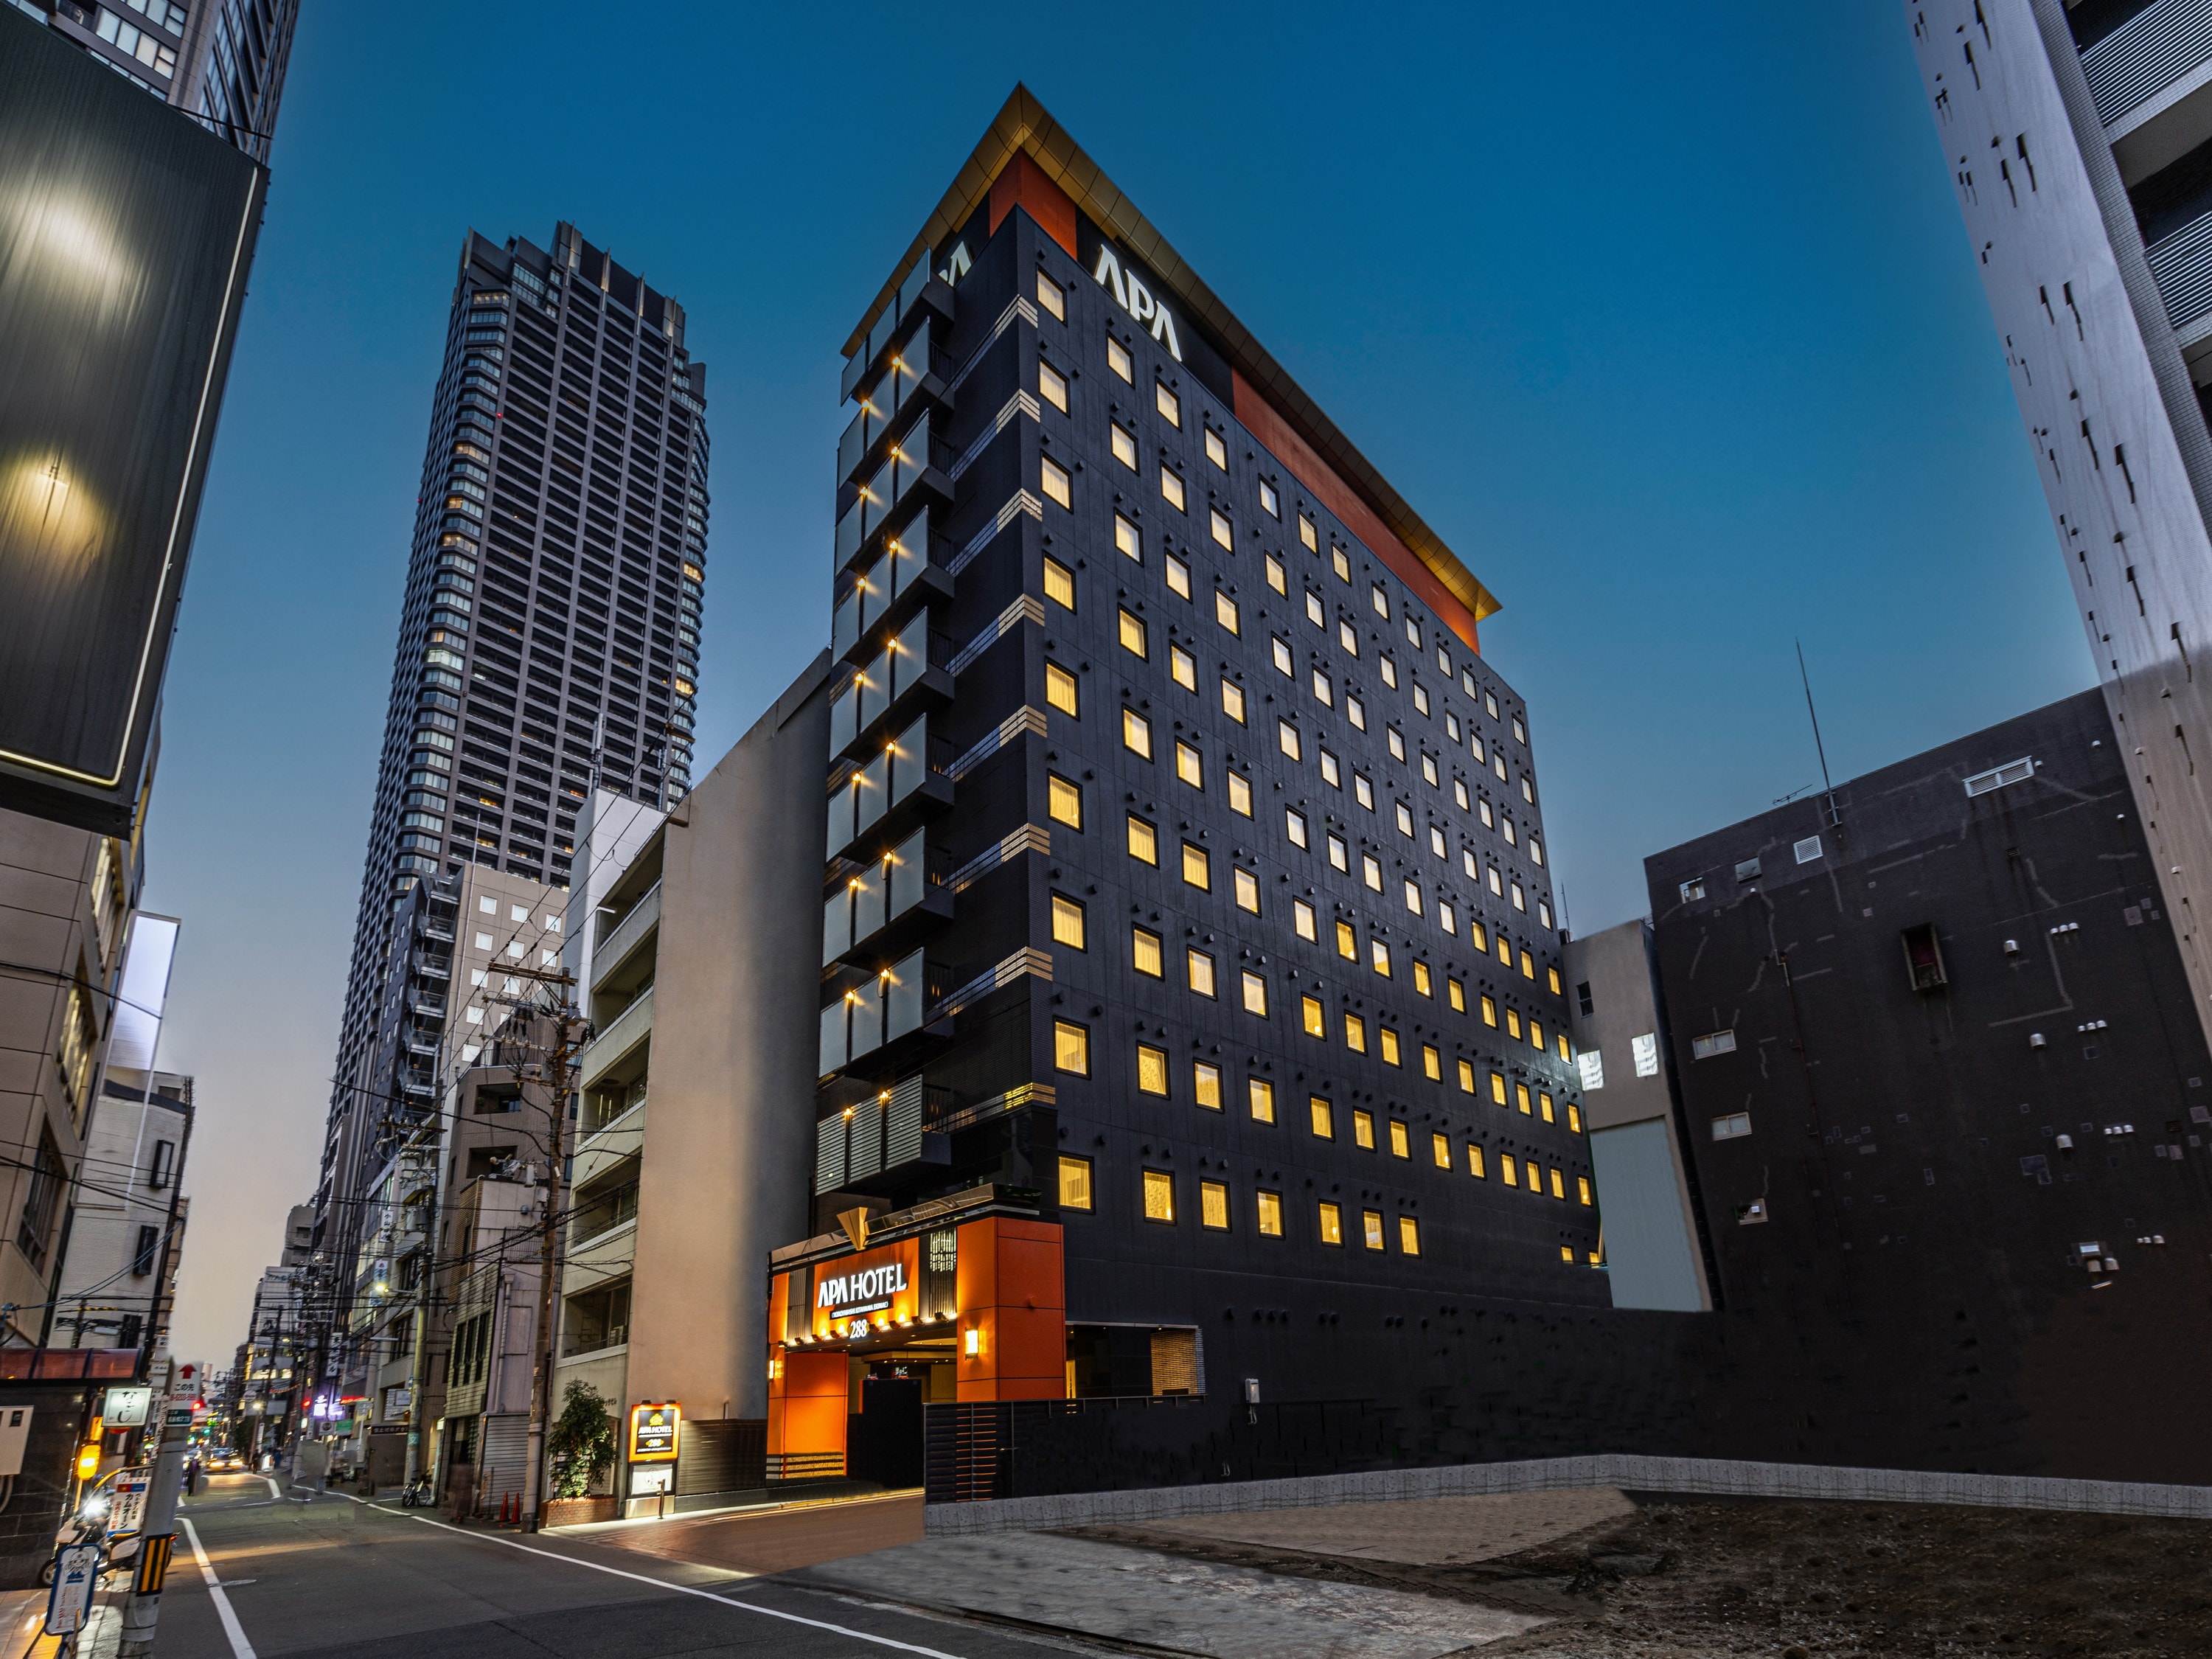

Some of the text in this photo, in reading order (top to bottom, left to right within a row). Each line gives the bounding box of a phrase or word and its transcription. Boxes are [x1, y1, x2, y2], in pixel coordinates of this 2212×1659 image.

[1094, 243, 1182, 362] APA
[817, 1263, 907, 1309] APA HOTEL
[849, 1318, 868, 1339] 288
[173, 1383, 195, 1391] この先
[652, 1425, 673, 1434] HOTEL
[119, 1493, 133, 1529] カムオーン
